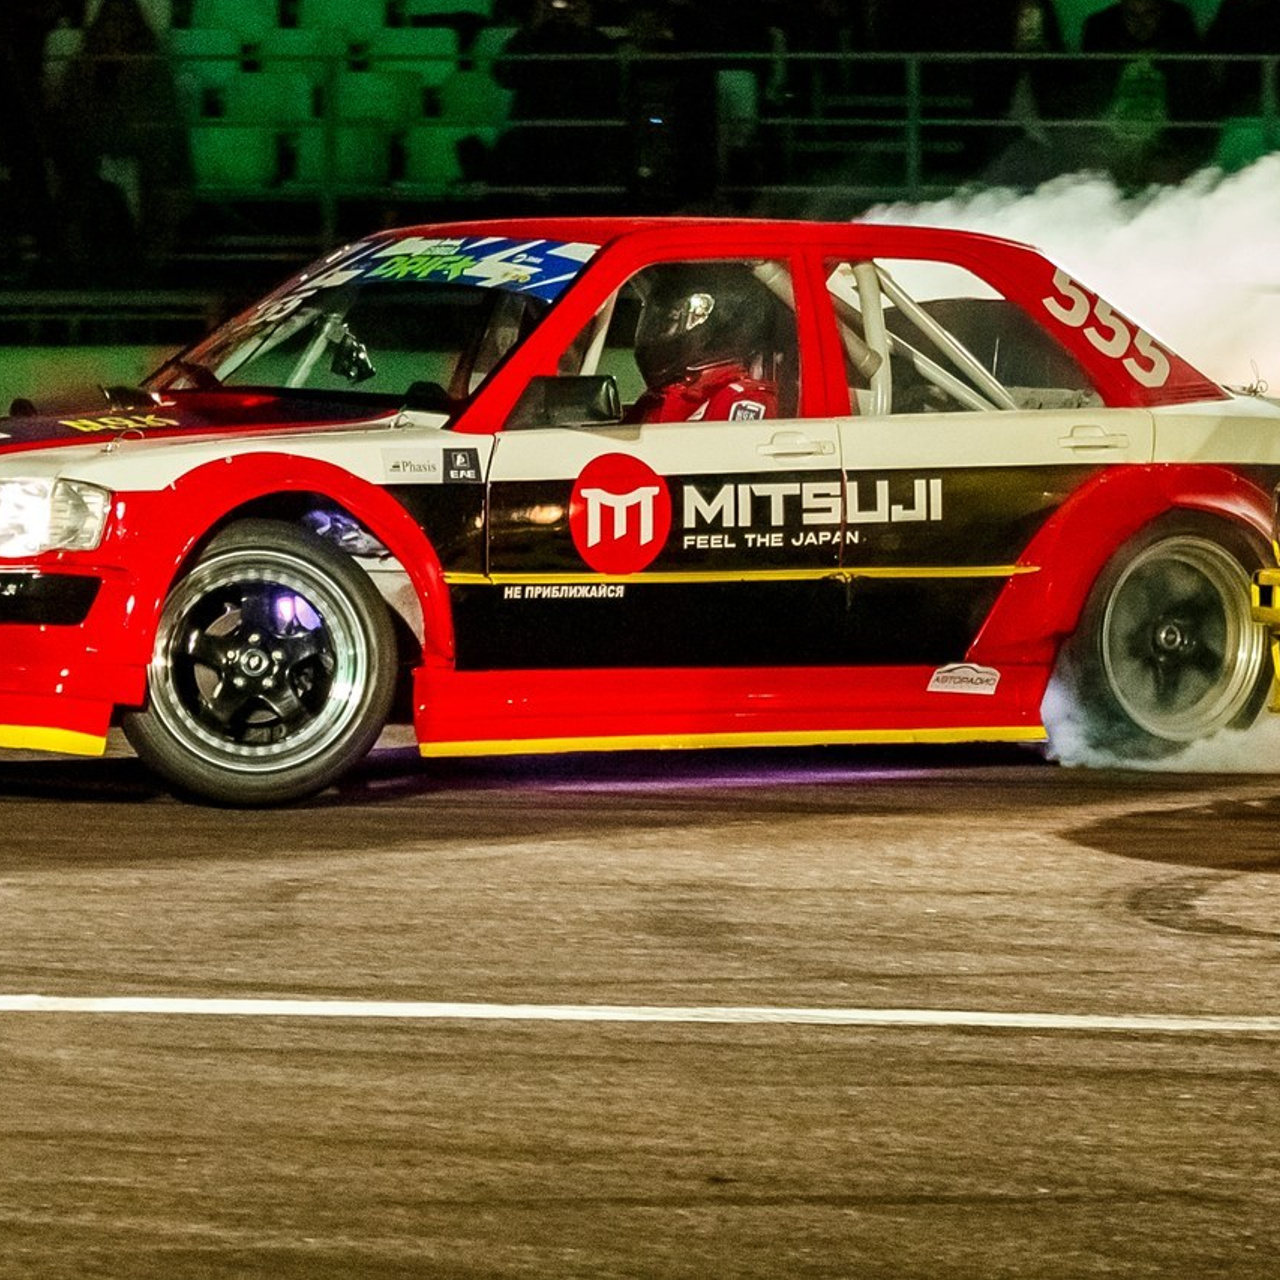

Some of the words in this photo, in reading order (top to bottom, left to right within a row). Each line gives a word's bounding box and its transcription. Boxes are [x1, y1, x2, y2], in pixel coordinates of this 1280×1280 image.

[1041, 267, 1171, 388] 555
[402, 460, 437, 473] Phasis
[683, 478, 942, 528] MITSUJI
[683, 535, 736, 549] FEEL
[744, 533, 783, 547] THE
[791, 530, 859, 546] JAPAN
[504, 586, 522, 599] НЕ
[524, 584, 625, 598] ПРИБЛИЖАЙСЯ
